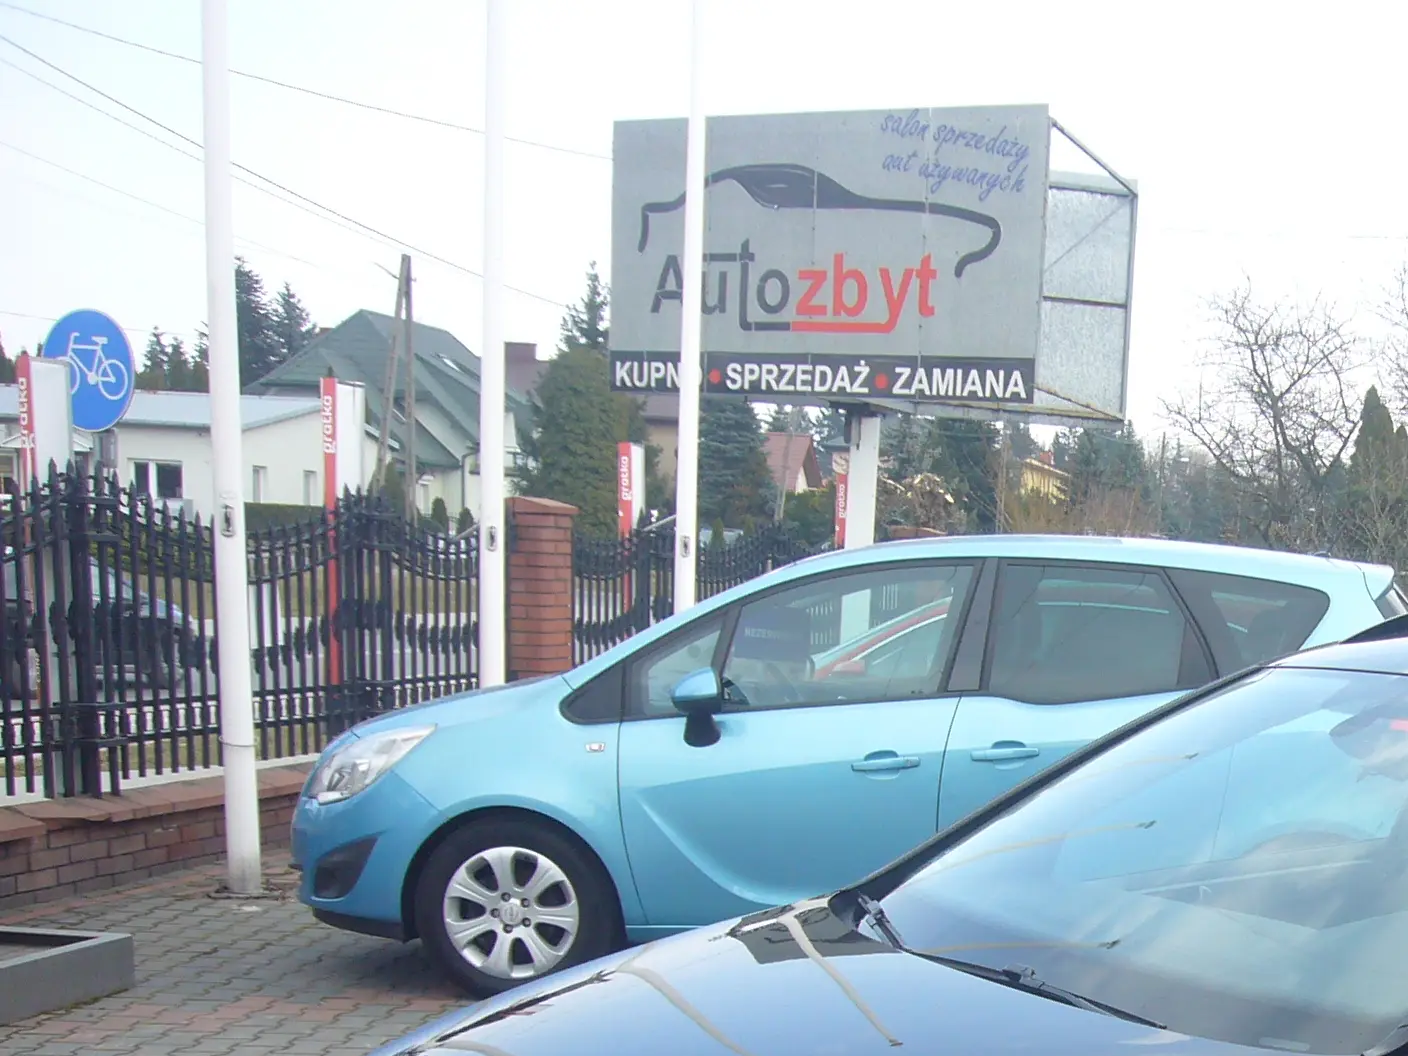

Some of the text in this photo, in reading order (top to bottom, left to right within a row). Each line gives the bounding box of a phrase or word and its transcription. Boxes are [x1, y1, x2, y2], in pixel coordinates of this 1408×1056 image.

[881, 108, 1030, 173] salon sprzedaży
[882, 150, 1028, 202] aut używanych
[725, 358, 870, 393] SPRZEDAŻ
[892, 367, 1027, 399] ZAMIANA
[321, 395, 336, 453] gratka
[619, 456, 633, 501] gratka
